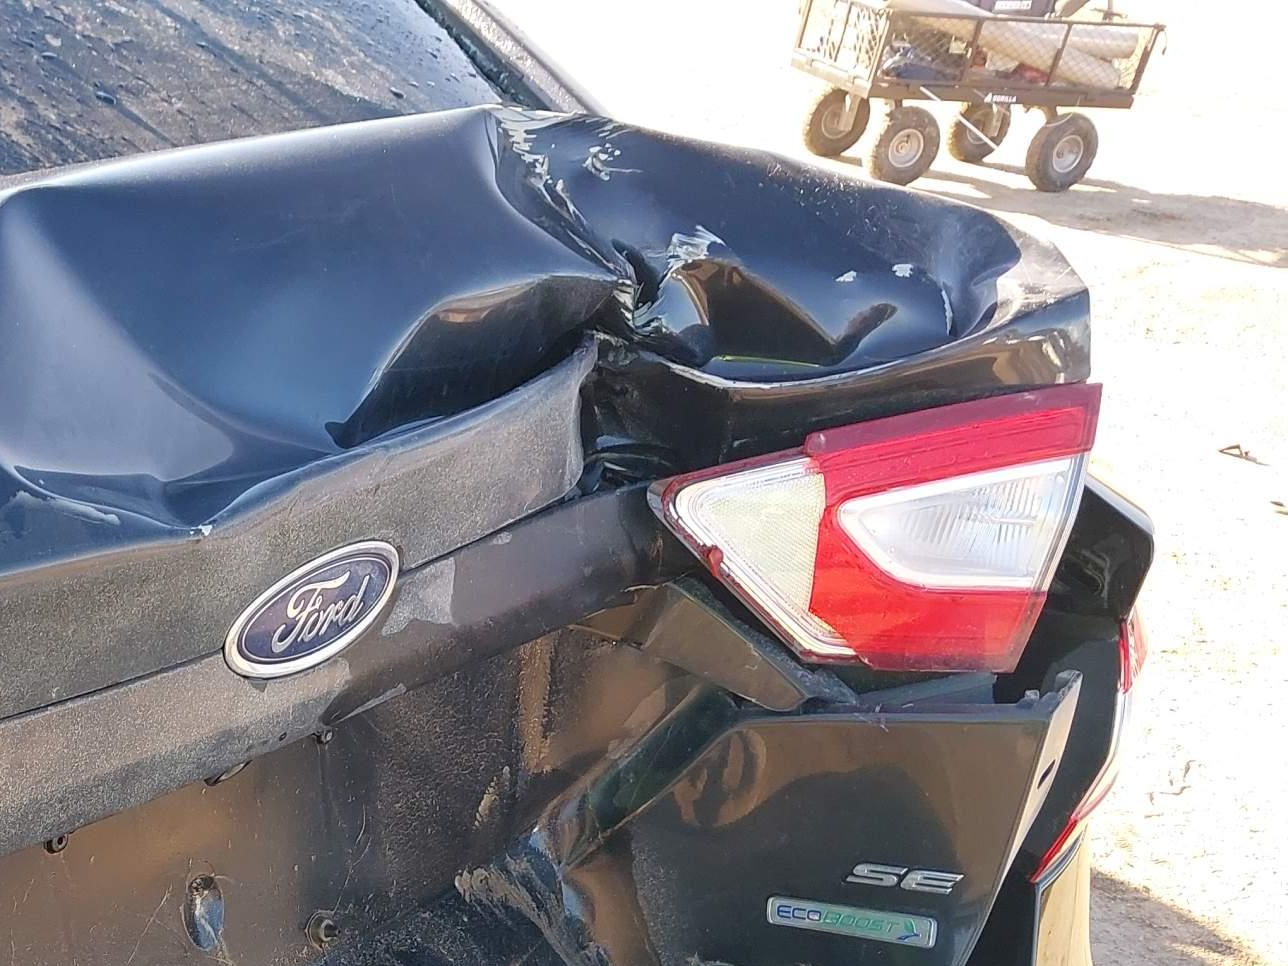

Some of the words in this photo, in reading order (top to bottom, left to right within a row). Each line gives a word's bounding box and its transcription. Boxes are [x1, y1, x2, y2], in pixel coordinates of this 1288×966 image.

[272, 570, 372, 653] Ford
[845, 863, 965, 895] SE
[776, 904, 900, 933] ECOBOOST
